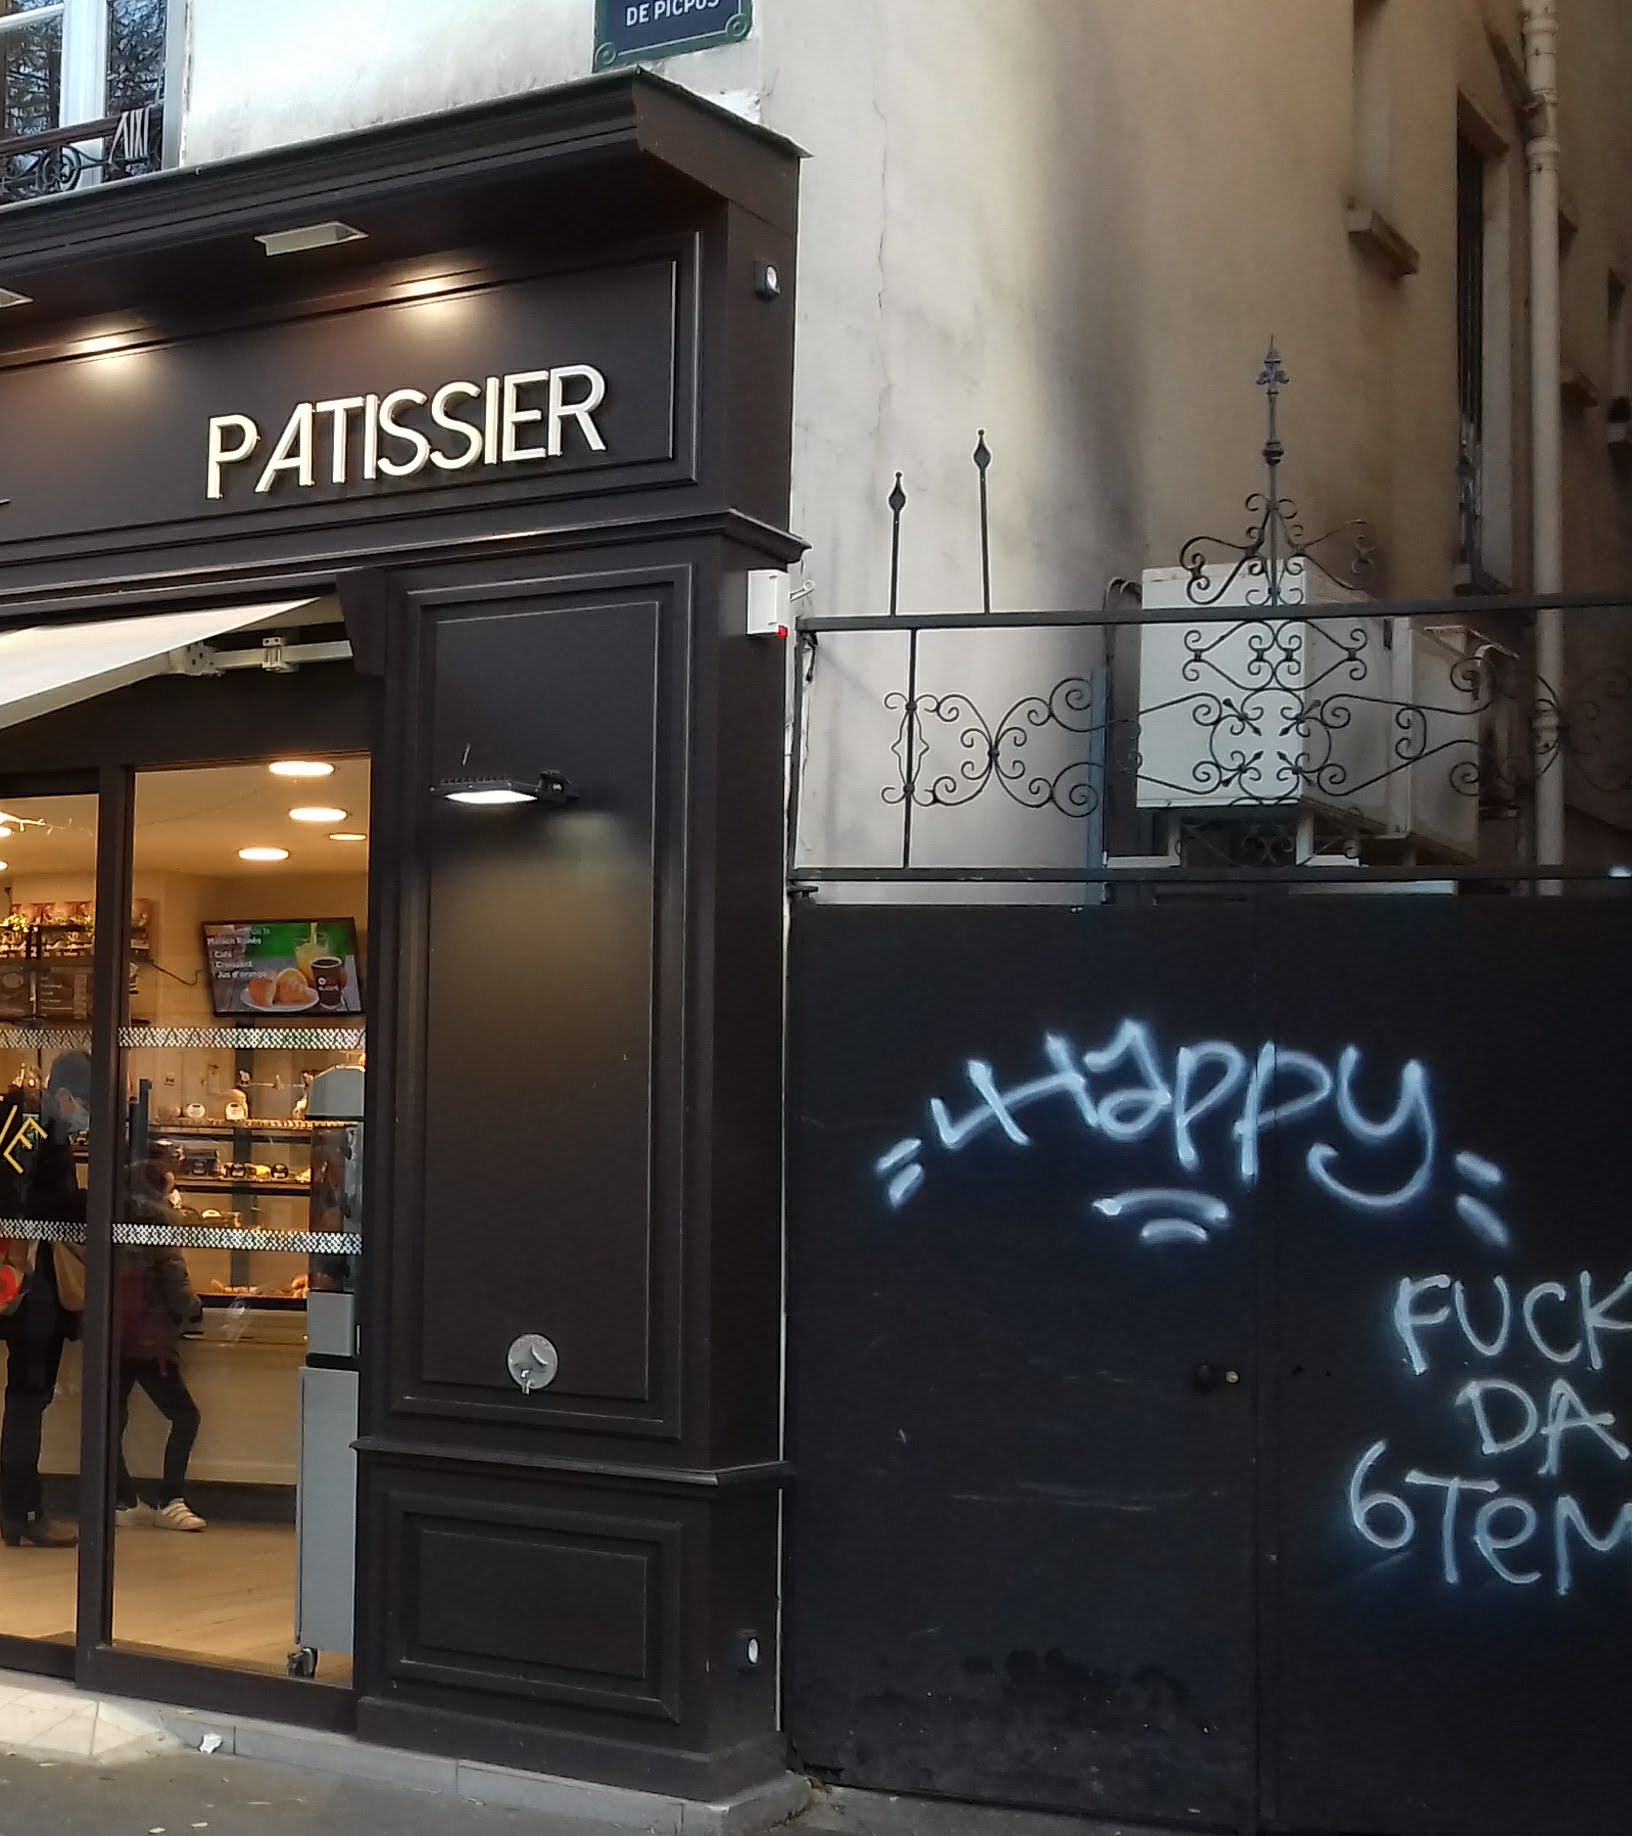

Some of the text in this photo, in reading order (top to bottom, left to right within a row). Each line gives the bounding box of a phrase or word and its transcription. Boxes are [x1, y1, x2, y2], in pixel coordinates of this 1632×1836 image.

[626, 3, 650, 26] DE
[206, 364, 607, 499] PATISSIER
[1394, 1270, 1632, 1376] FUCK
[1454, 1378, 1631, 1477] DA
